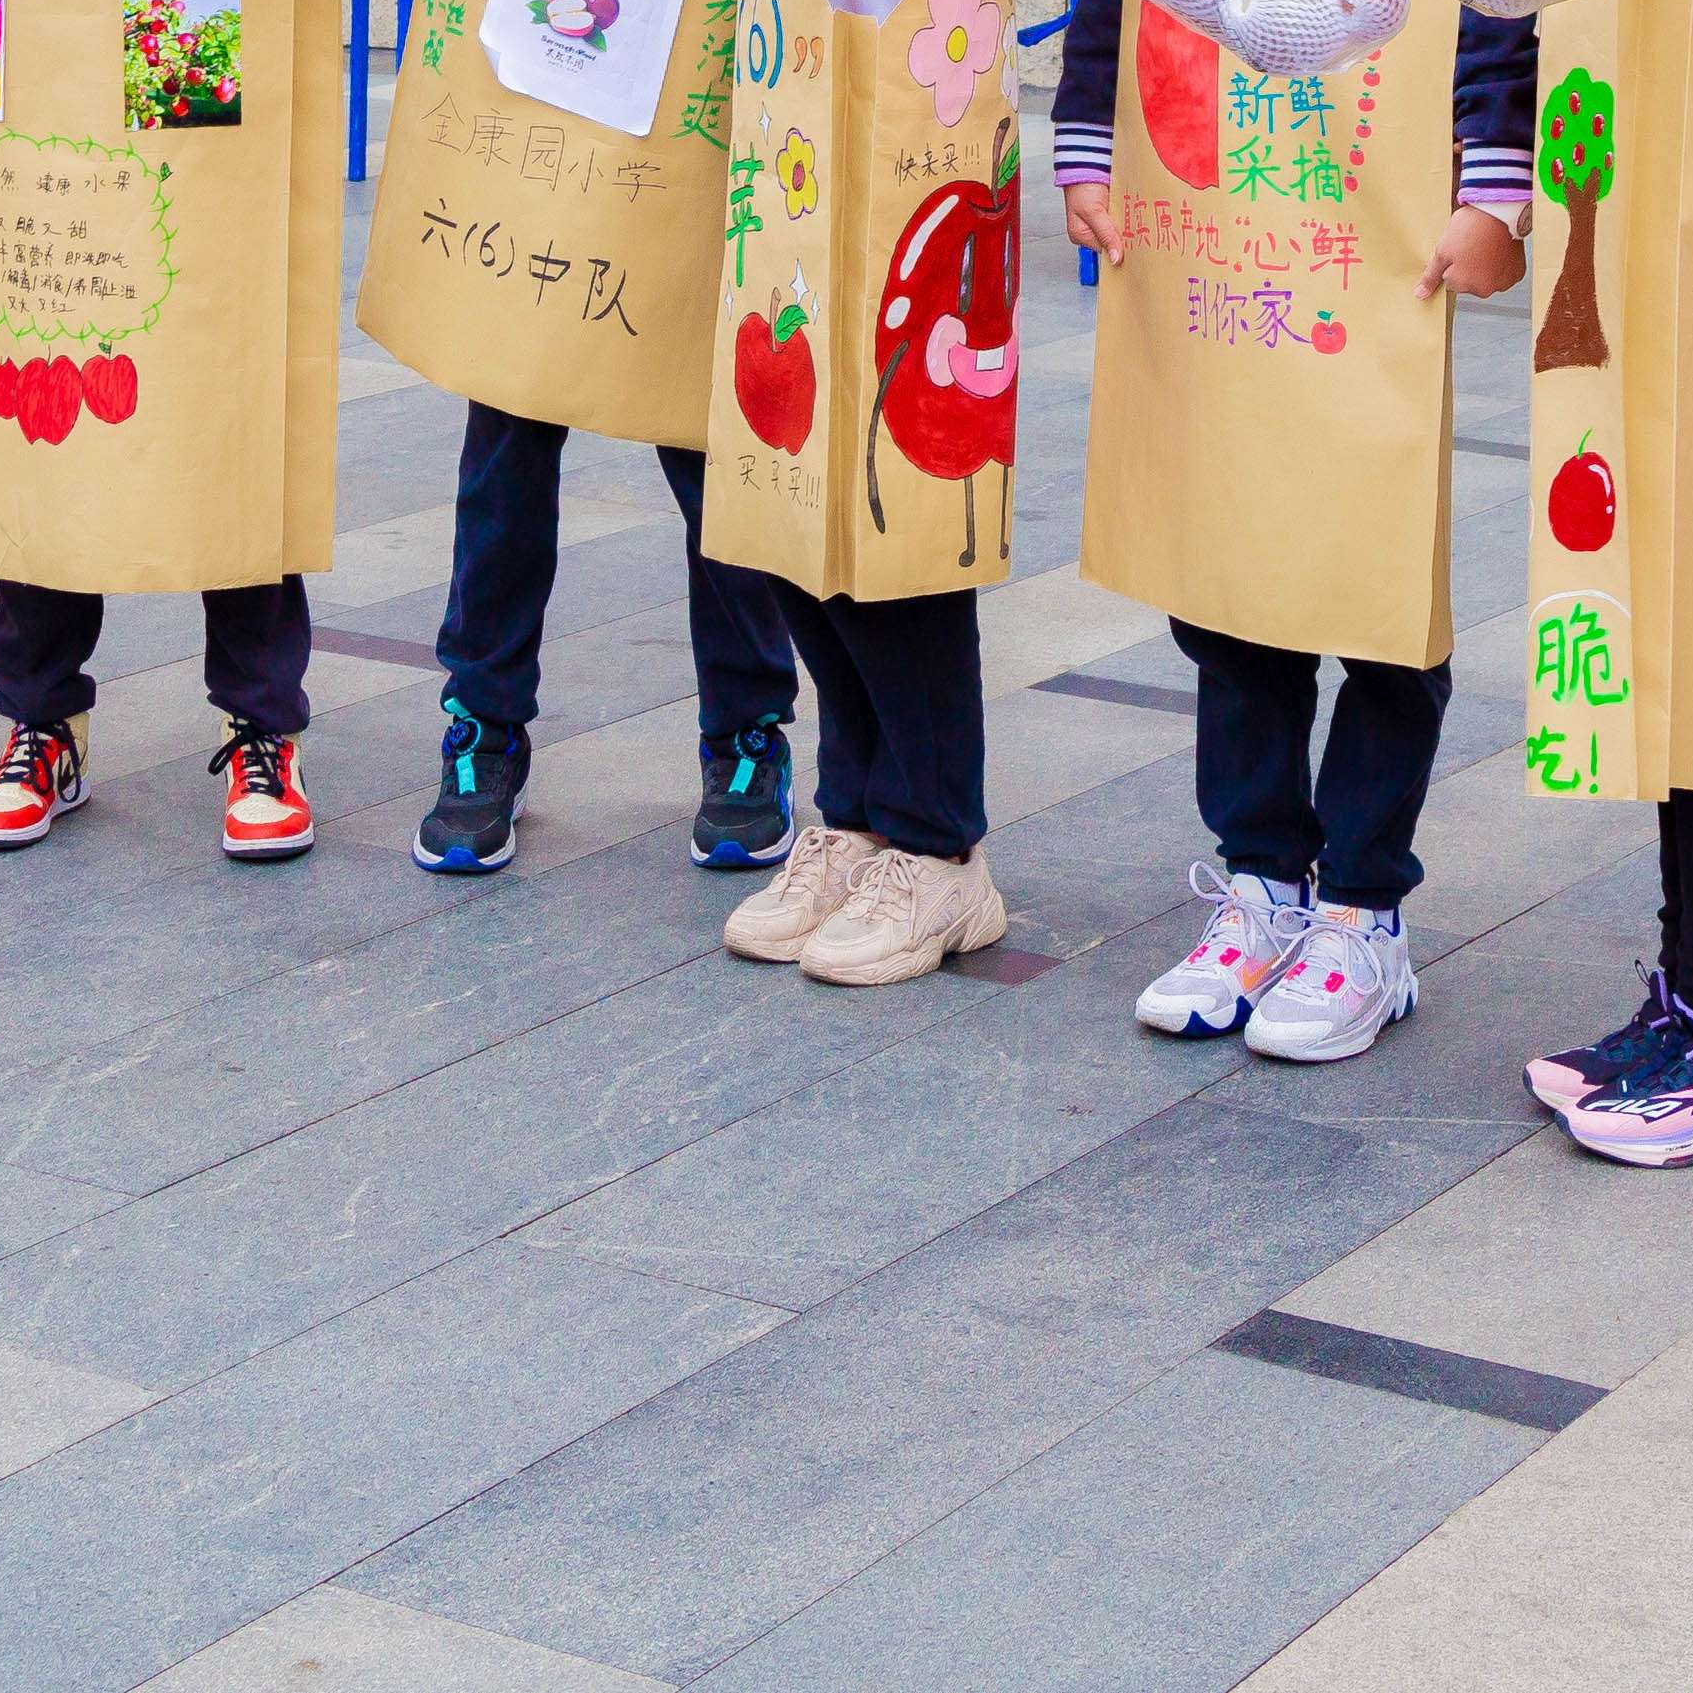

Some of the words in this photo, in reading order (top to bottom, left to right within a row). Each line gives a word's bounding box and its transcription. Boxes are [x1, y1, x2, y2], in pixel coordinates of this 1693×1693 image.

[1227, 71, 1335, 138] 新鲜
[421, 91, 668, 204] 金康园小学
[1226, 135, 1344, 204] 采摘
[421, 198, 639, 337] 六(6)中队
[1188, 277, 1314, 349] 到你家
[1535, 602, 1629, 707] 脆
[1526, 725, 1599, 795] 吃!
